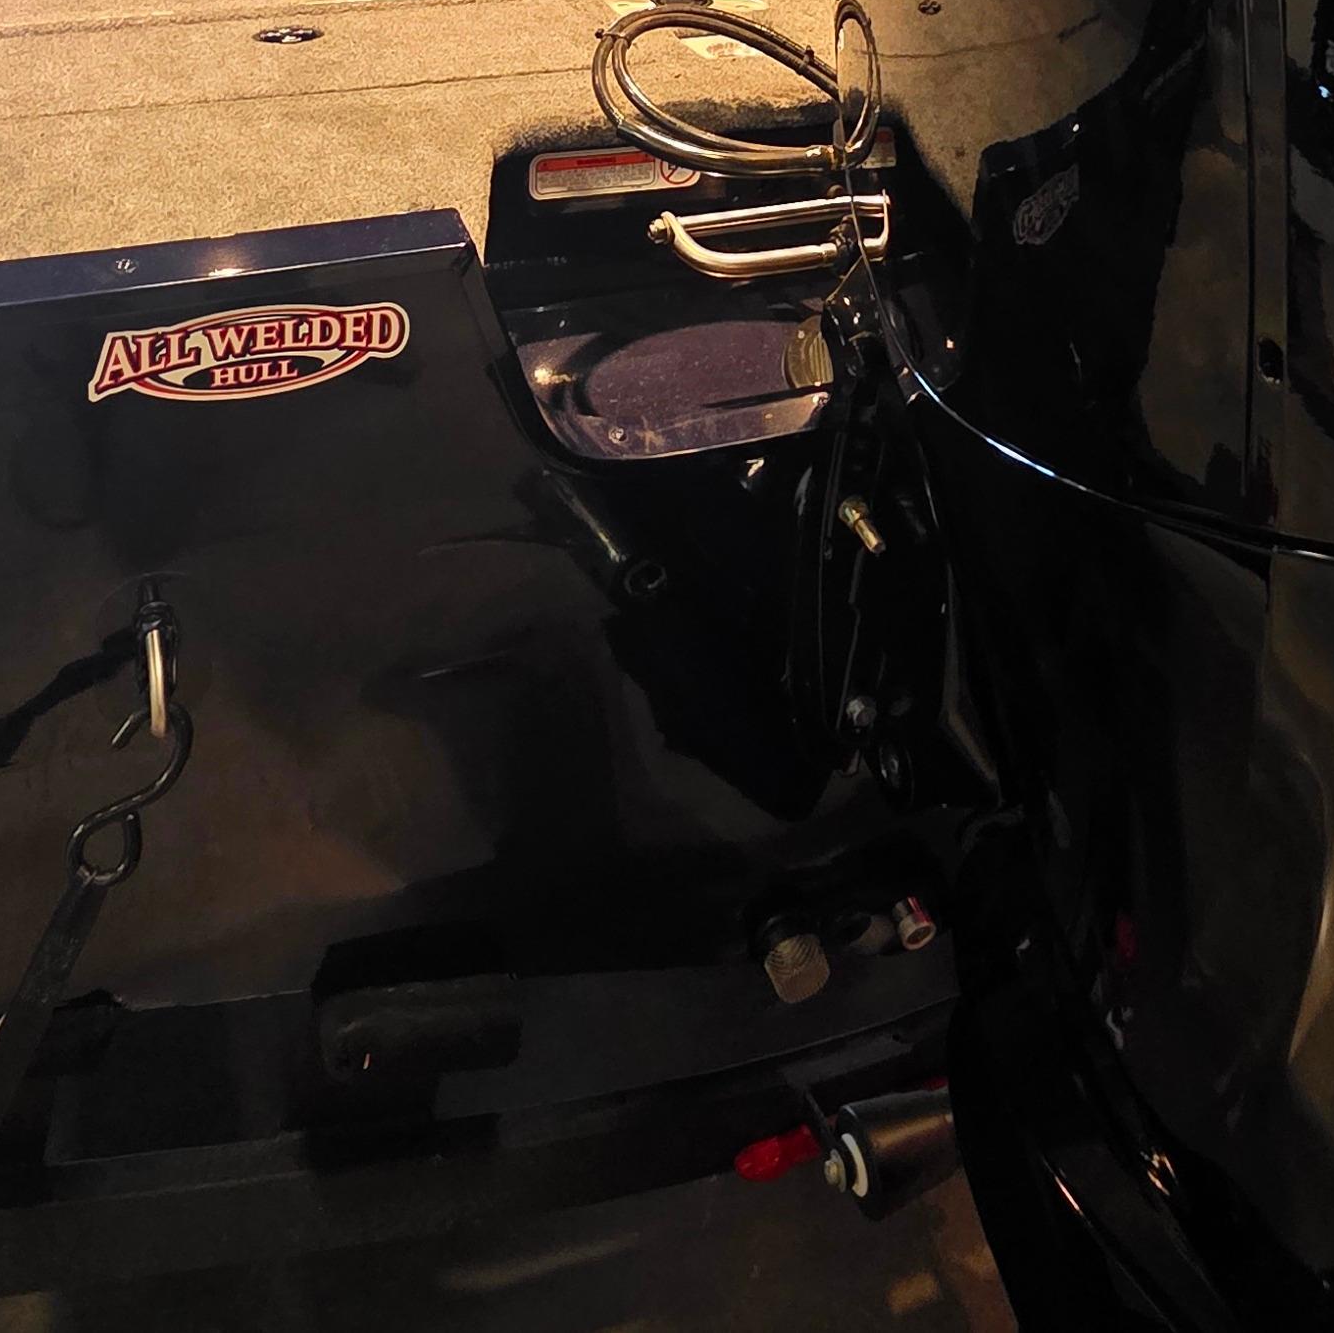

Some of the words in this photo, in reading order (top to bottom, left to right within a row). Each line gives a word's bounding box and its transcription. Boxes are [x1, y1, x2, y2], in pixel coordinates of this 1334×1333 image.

[97, 334, 202, 390] ALL
[207, 310, 400, 358] WELDED
[211, 360, 298, 387] HULL
